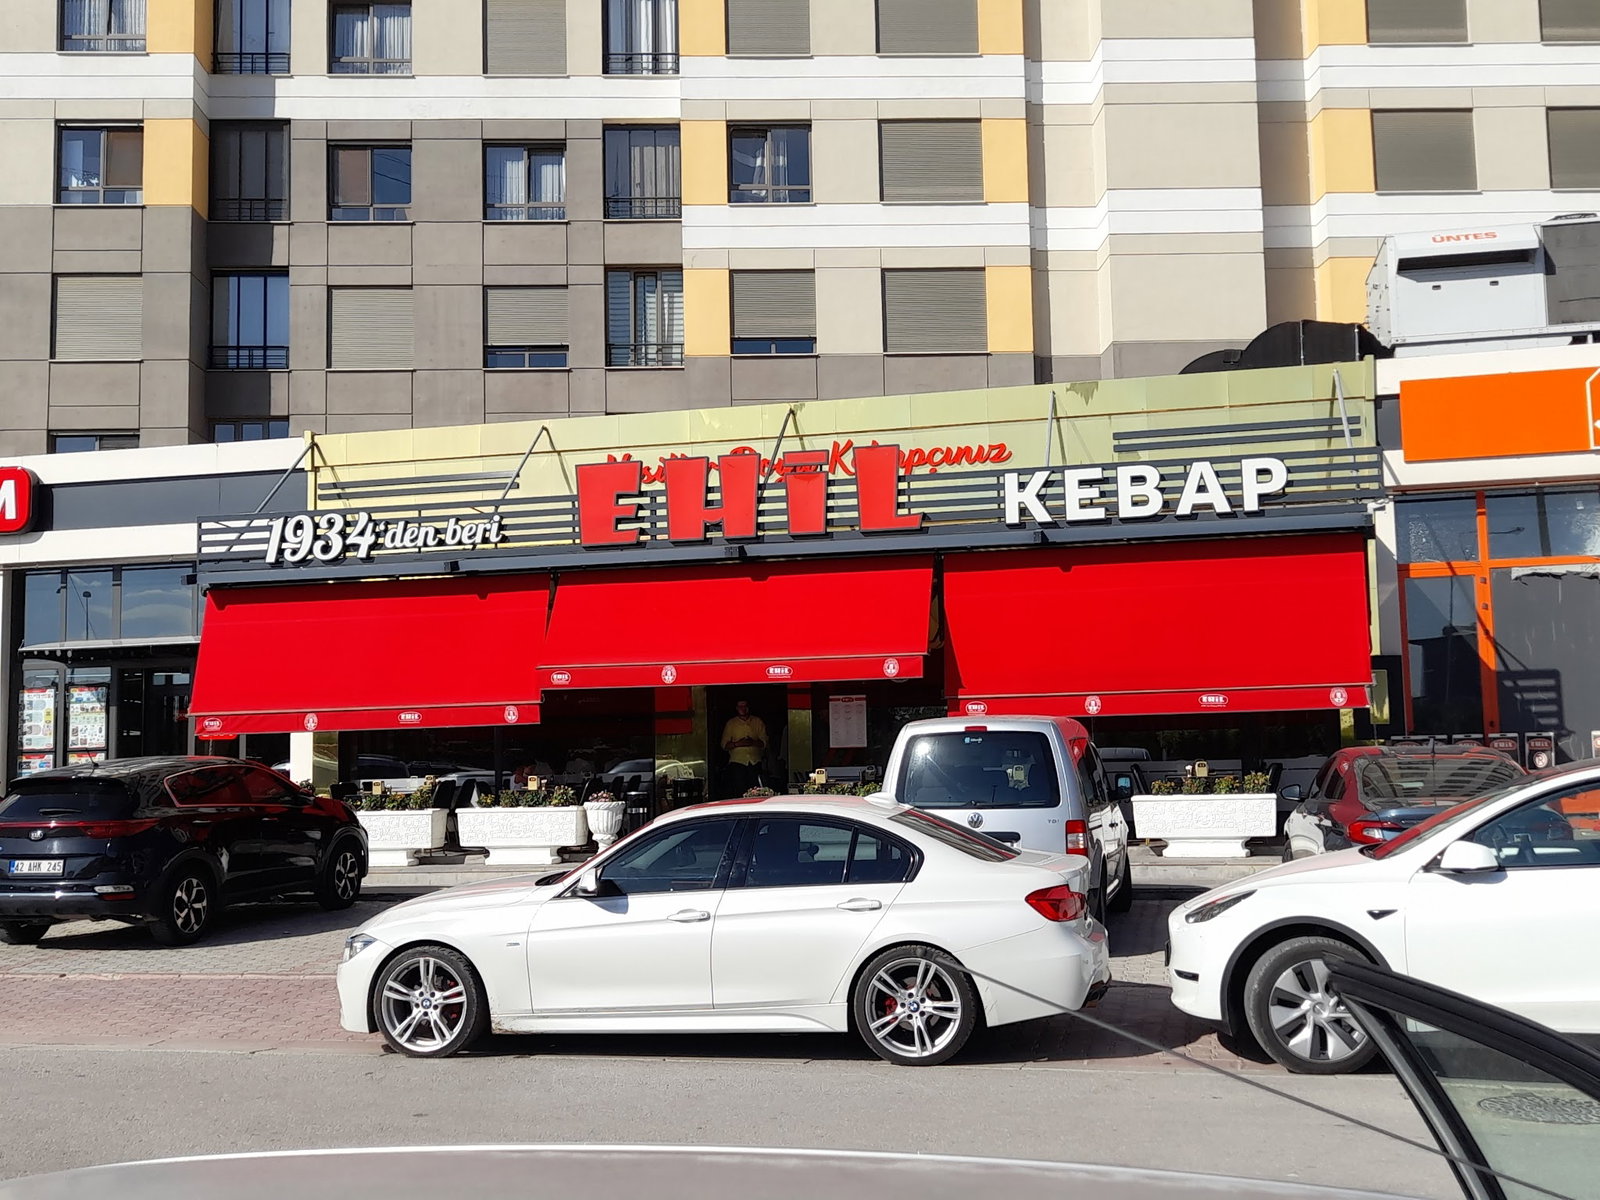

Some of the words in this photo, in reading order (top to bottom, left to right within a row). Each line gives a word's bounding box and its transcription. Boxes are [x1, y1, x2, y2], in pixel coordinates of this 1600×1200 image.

[1431, 231, 1498, 244] ÜNTES
[1003, 457, 1290, 525] KEBAP
[445, 514, 502, 546] beri
[15, 861, 24, 872] 42
[46, 861, 62, 872] 245
